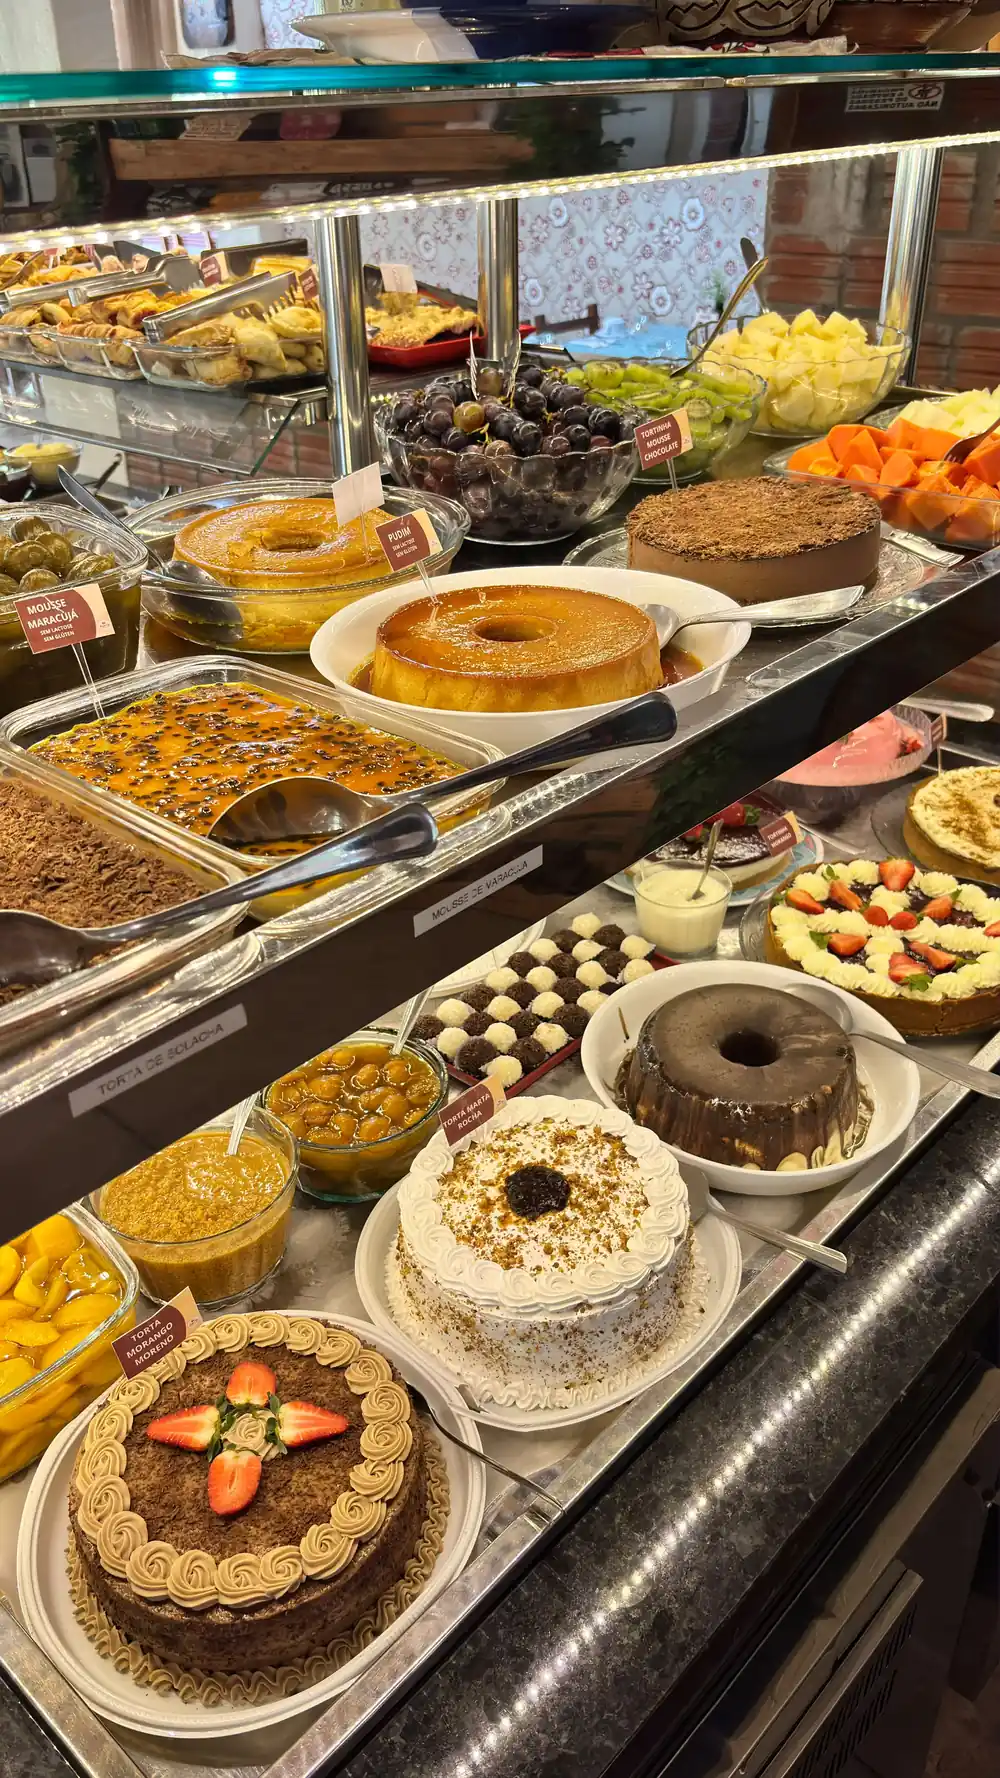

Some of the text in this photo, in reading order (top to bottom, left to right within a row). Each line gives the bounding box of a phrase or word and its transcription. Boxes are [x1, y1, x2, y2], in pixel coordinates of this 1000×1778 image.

[641, 420, 672, 438] TORTINHA
[646, 433, 671, 448] MOUSSE
[644, 441, 679, 461] CHOCOLATE
[387, 526, 412, 543] PUDIM
[26, 598, 67, 615] MOUSSE
[27, 608, 79, 630] MARACUJÁ
[40, 623, 73, 636] SEM LACTOSE
[55, 630, 75, 640] GLÚTEN
[472, 885, 484, 898] DE
[97, 1067, 143, 1095] TORTA
[146, 1055, 164, 1070] DE
[443, 1093, 490, 1128] TORTA MARTA
[457, 1110, 482, 1130] ROCHA
[126, 1322, 173, 1359] MORANGO
[130, 1319, 161, 1342] TORTA
[134, 1334, 174, 1366] MORENO
